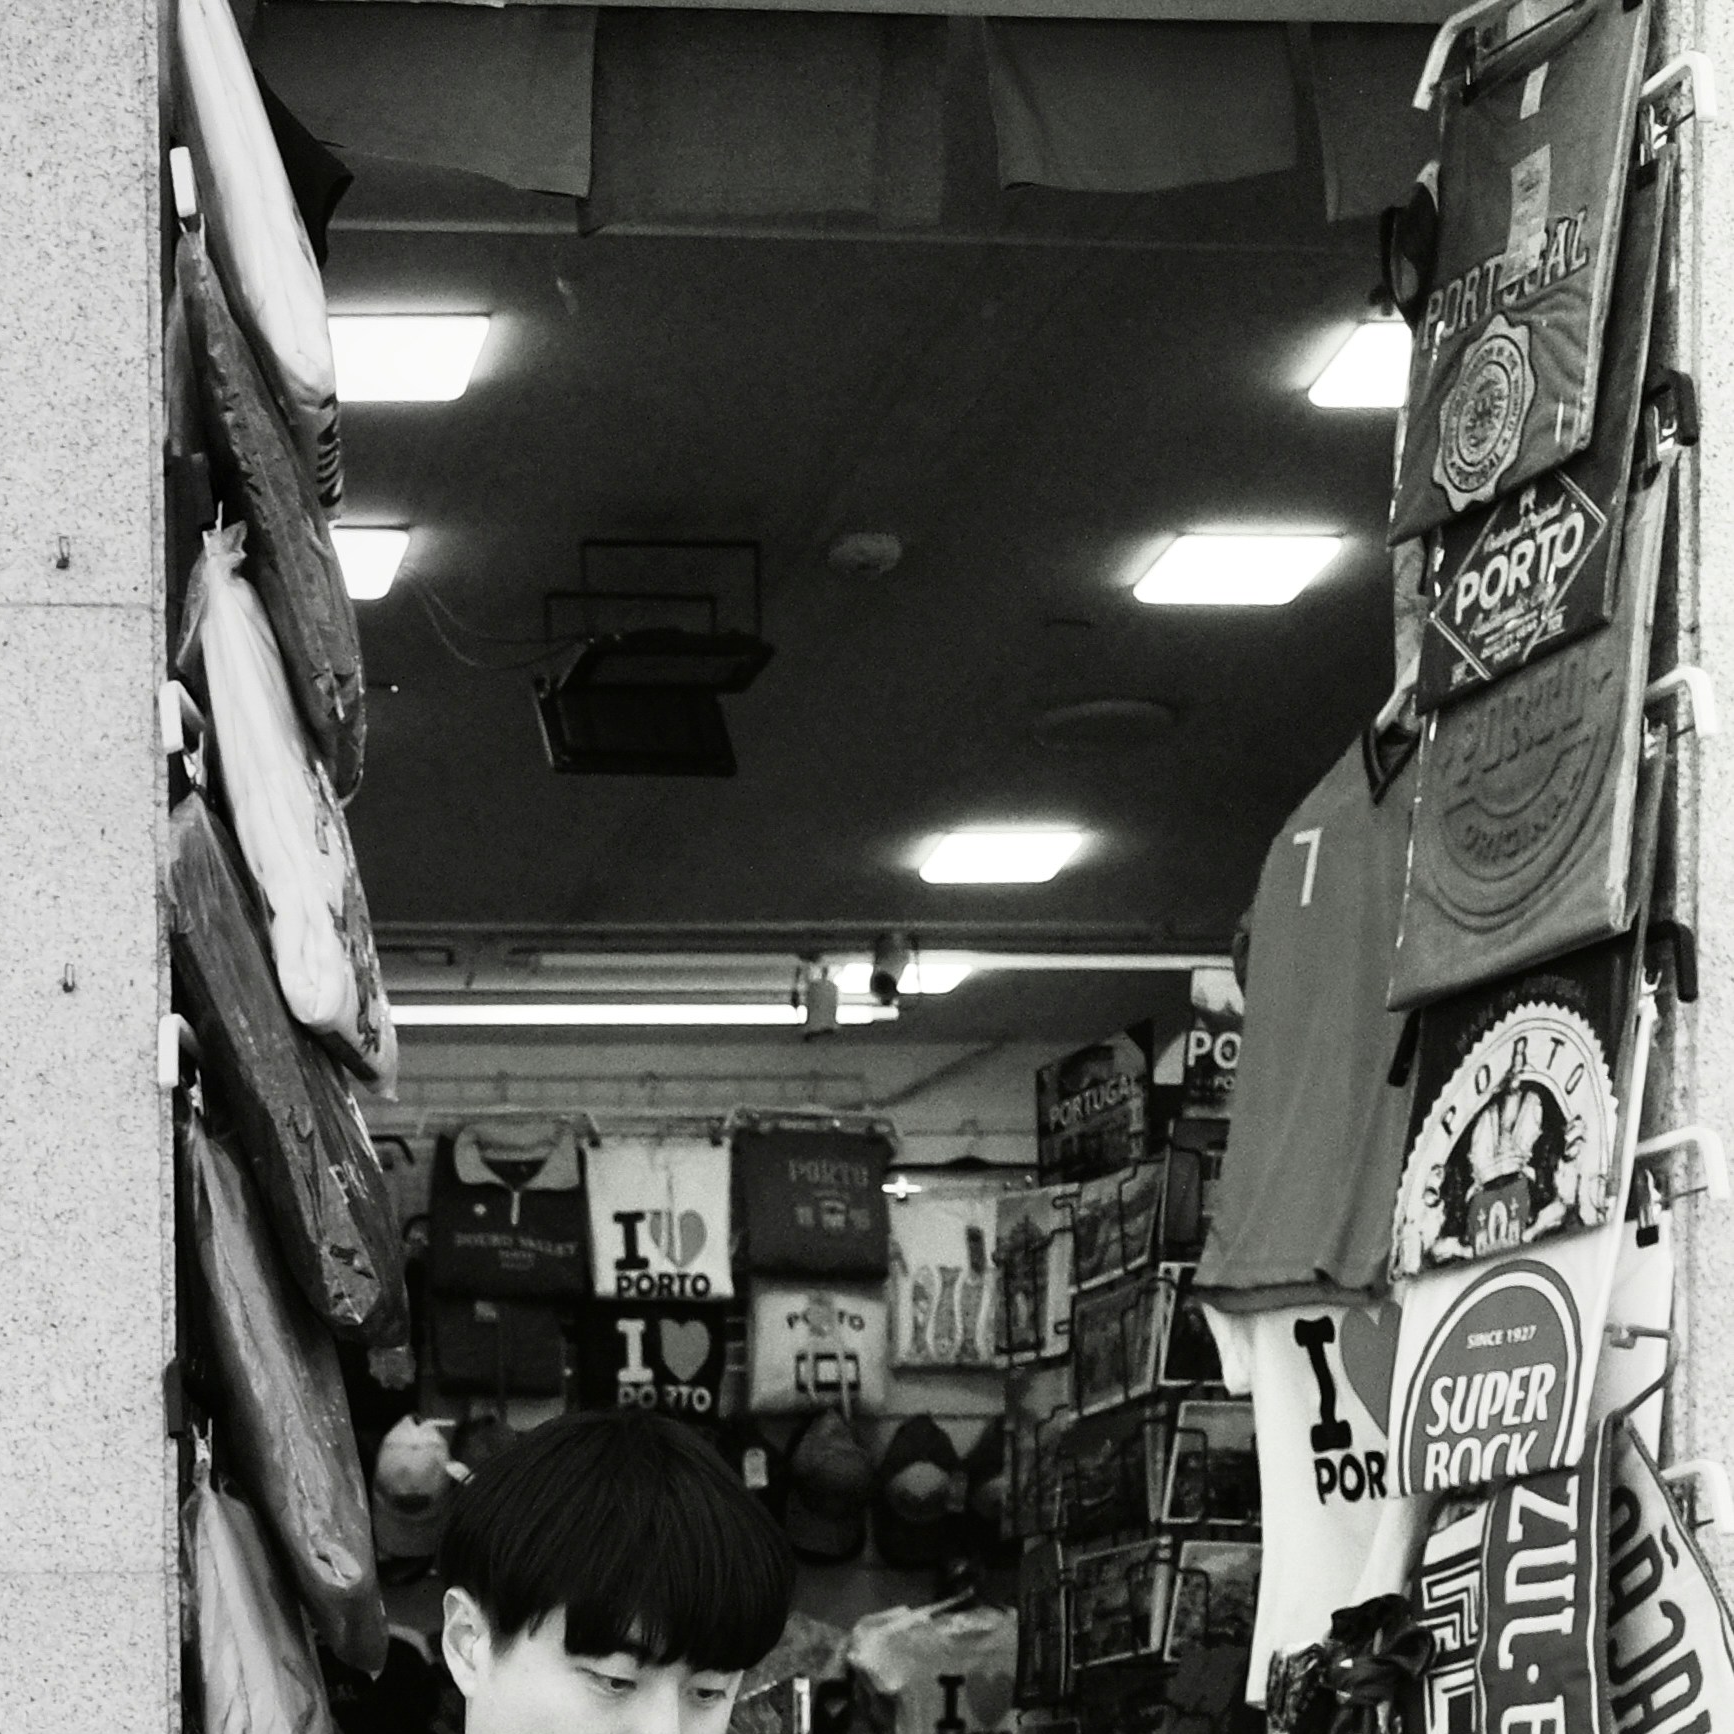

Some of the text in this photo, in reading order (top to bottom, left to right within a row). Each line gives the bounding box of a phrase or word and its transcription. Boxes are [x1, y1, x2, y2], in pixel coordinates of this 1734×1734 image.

[1455, 512, 1585, 626] PORTO
[1293, 828, 1323, 907] 7
[1441, 1036, 1585, 1136] PORTO
[613, 1212, 649, 1270] I
[617, 1273, 711, 1299] PORTO
[617, 1318, 654, 1383] I
[1466, 1324, 1537, 1349] SINCE 1927
[618, 1384, 712, 1412] PORTO
[1294, 1316, 1352, 1453] I
[1425, 1363, 1557, 1437] SUPER
[1314, 1450, 1387, 1505] POR
[1424, 1430, 1539, 1492] ROCK
[937, 1674, 965, 1730] I
